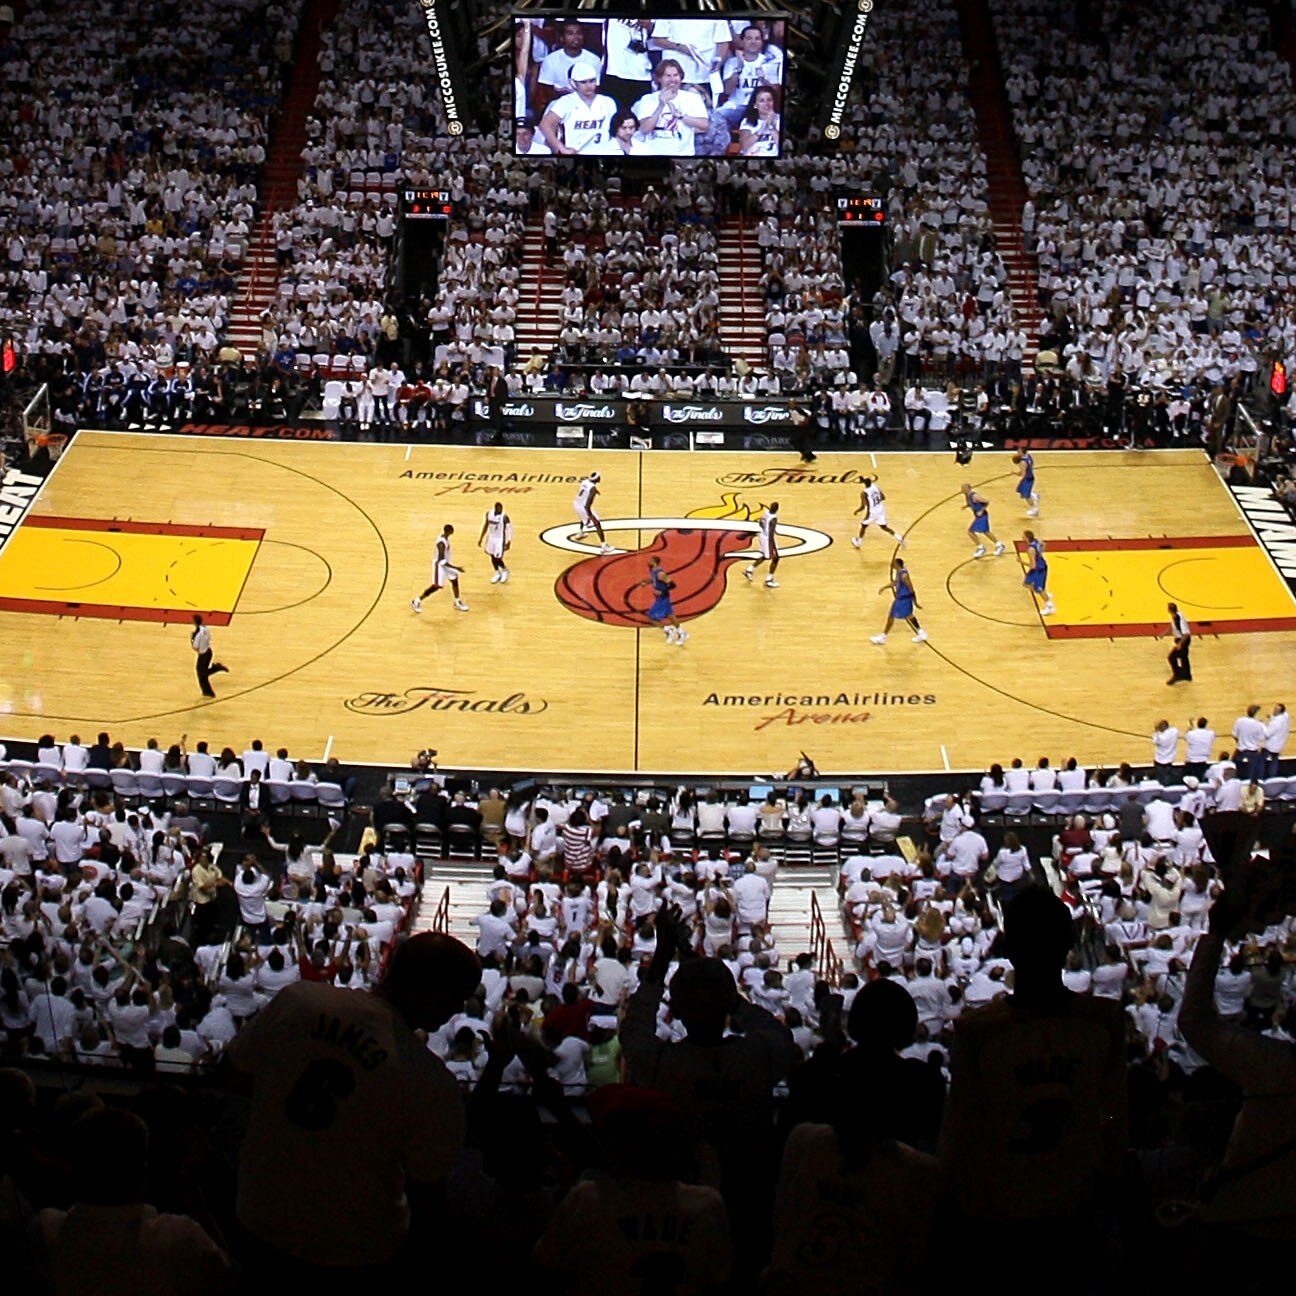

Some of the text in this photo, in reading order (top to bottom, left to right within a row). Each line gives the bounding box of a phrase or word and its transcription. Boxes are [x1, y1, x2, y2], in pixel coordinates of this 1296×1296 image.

[427, 8, 458, 120] MICCOSUKEE.COM
[831, 13, 868, 125] MICCOSUKEE.COM
[574, 117, 606, 131] HEAT
[593, 133, 602, 145] 3
[570, 402, 616, 420] Finals
[678, 403, 724, 422] Finals
[399, 469, 590, 485] AmericanAirlines
[725, 472, 766, 485] The
[433, 481, 534, 497] Arena
[350, 687, 548, 715] The Finals
[702, 692, 937, 706] AmericanAirlines
[754, 708, 872, 731] Arena
[309, 1013, 389, 1071] JAMES
[286, 1058, 355, 1131] 6
